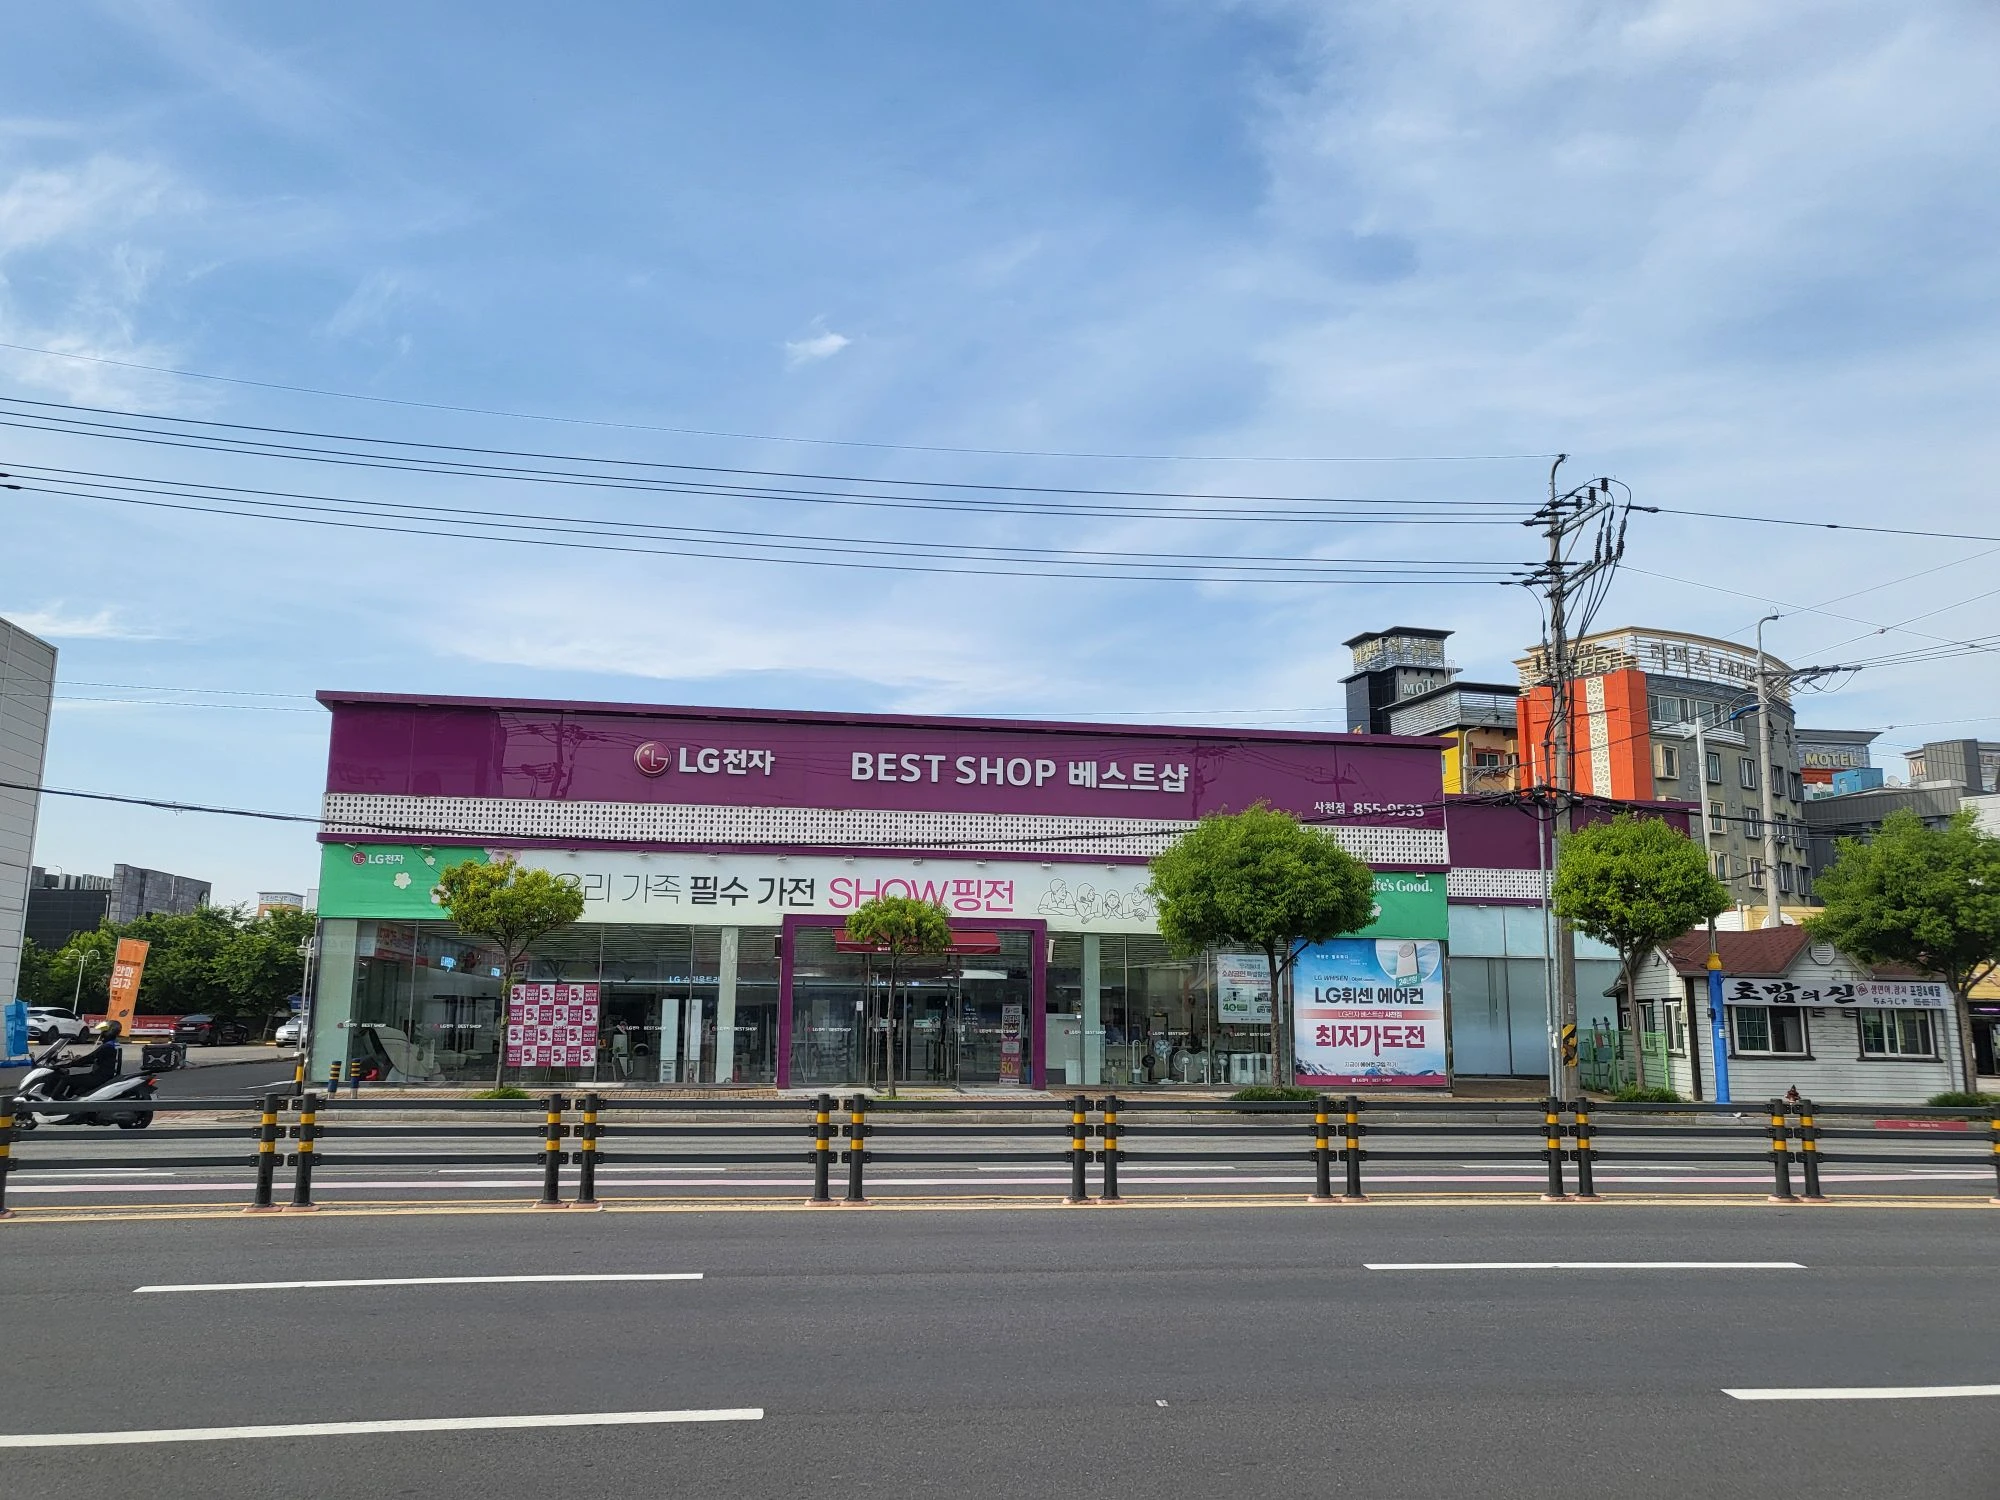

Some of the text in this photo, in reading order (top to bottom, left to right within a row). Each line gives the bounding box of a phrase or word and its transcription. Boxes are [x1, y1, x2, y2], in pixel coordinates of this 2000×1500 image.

[678, 747, 775, 776] LG전자
[1805, 753, 1858, 768] MOTEL
[851, 752, 1189, 793] BEST SHOP 베스트샵
[1314, 801, 1345, 815] 사천점
[368, 854, 404, 864] LG전자
[622, 874, 682, 904] 가족
[690, 876, 749, 906] 필수
[757, 877, 815, 906] 가전
[1396, 879, 1433, 892] Good.
[115, 965, 134, 977] 안마
[112, 977, 131, 989] 의자
[669, 976, 681, 984] LG
[1315, 987, 1424, 1005] LG휘센 에어컨
[1728, 981, 1801, 1003] 초밥의
[1824, 984, 1856, 1004] 신
[1385, 1010, 1403, 1018] 사천점
[1315, 1025, 1425, 1057] 최저가도전
